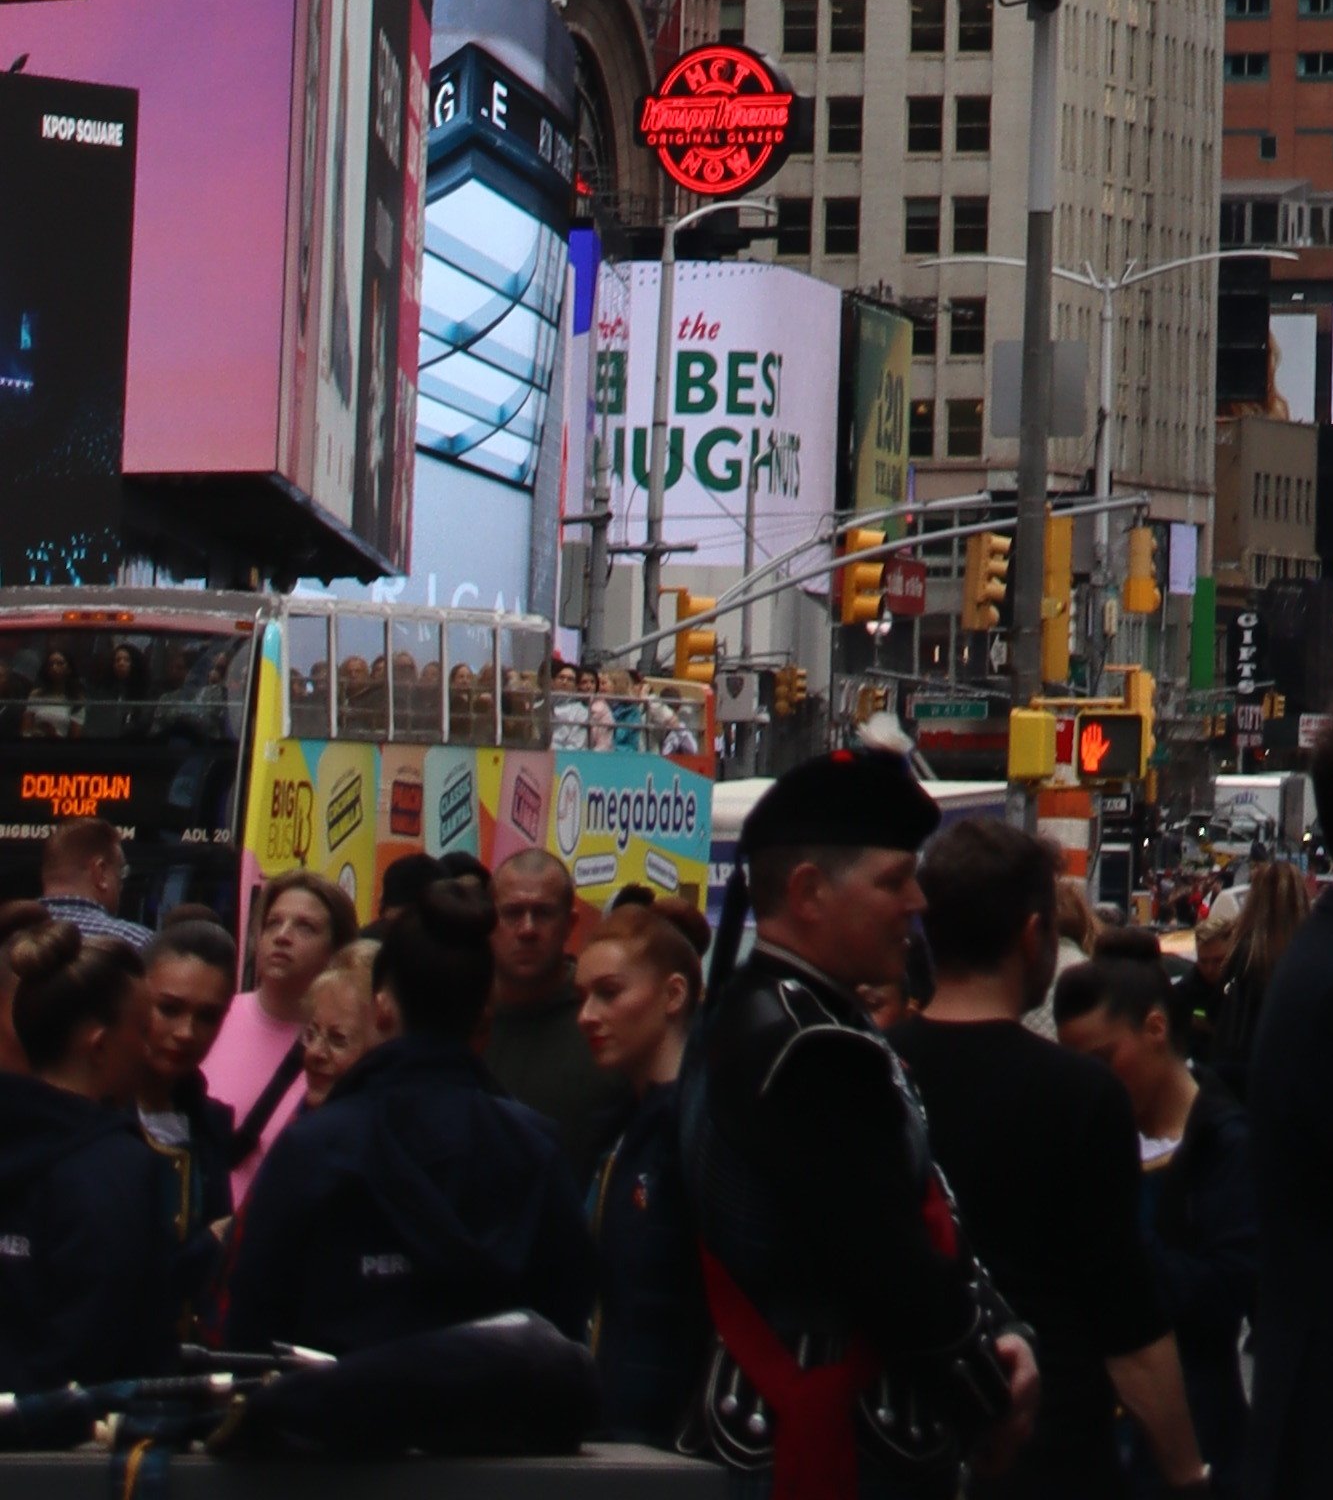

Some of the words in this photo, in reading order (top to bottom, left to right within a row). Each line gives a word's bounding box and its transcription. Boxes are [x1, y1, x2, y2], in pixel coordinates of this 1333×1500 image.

[684, 59, 751, 92] HOT
[42, 114, 76, 141] KPOP
[76, 118, 124, 147] SQUARE
[641, 98, 717, 132] Krispy
[715, 97, 789, 130] Kreme
[647, 132, 720, 146] ORIGINAL
[727, 130, 785, 144] GLAZED
[680, 147, 750, 183] NOW
[678, 312, 721, 341] the
[675, 350, 783, 418] BEST
[1237, 613, 1258, 694] GIFTS
[21, 774, 131, 800] DOWNTOWN
[271, 779, 295, 820] BIG
[52, 798, 97, 817] TOUR
[587, 773, 697, 849] megababe
[181, 828, 208, 843] ADL
[266, 819, 293, 860] BUS
